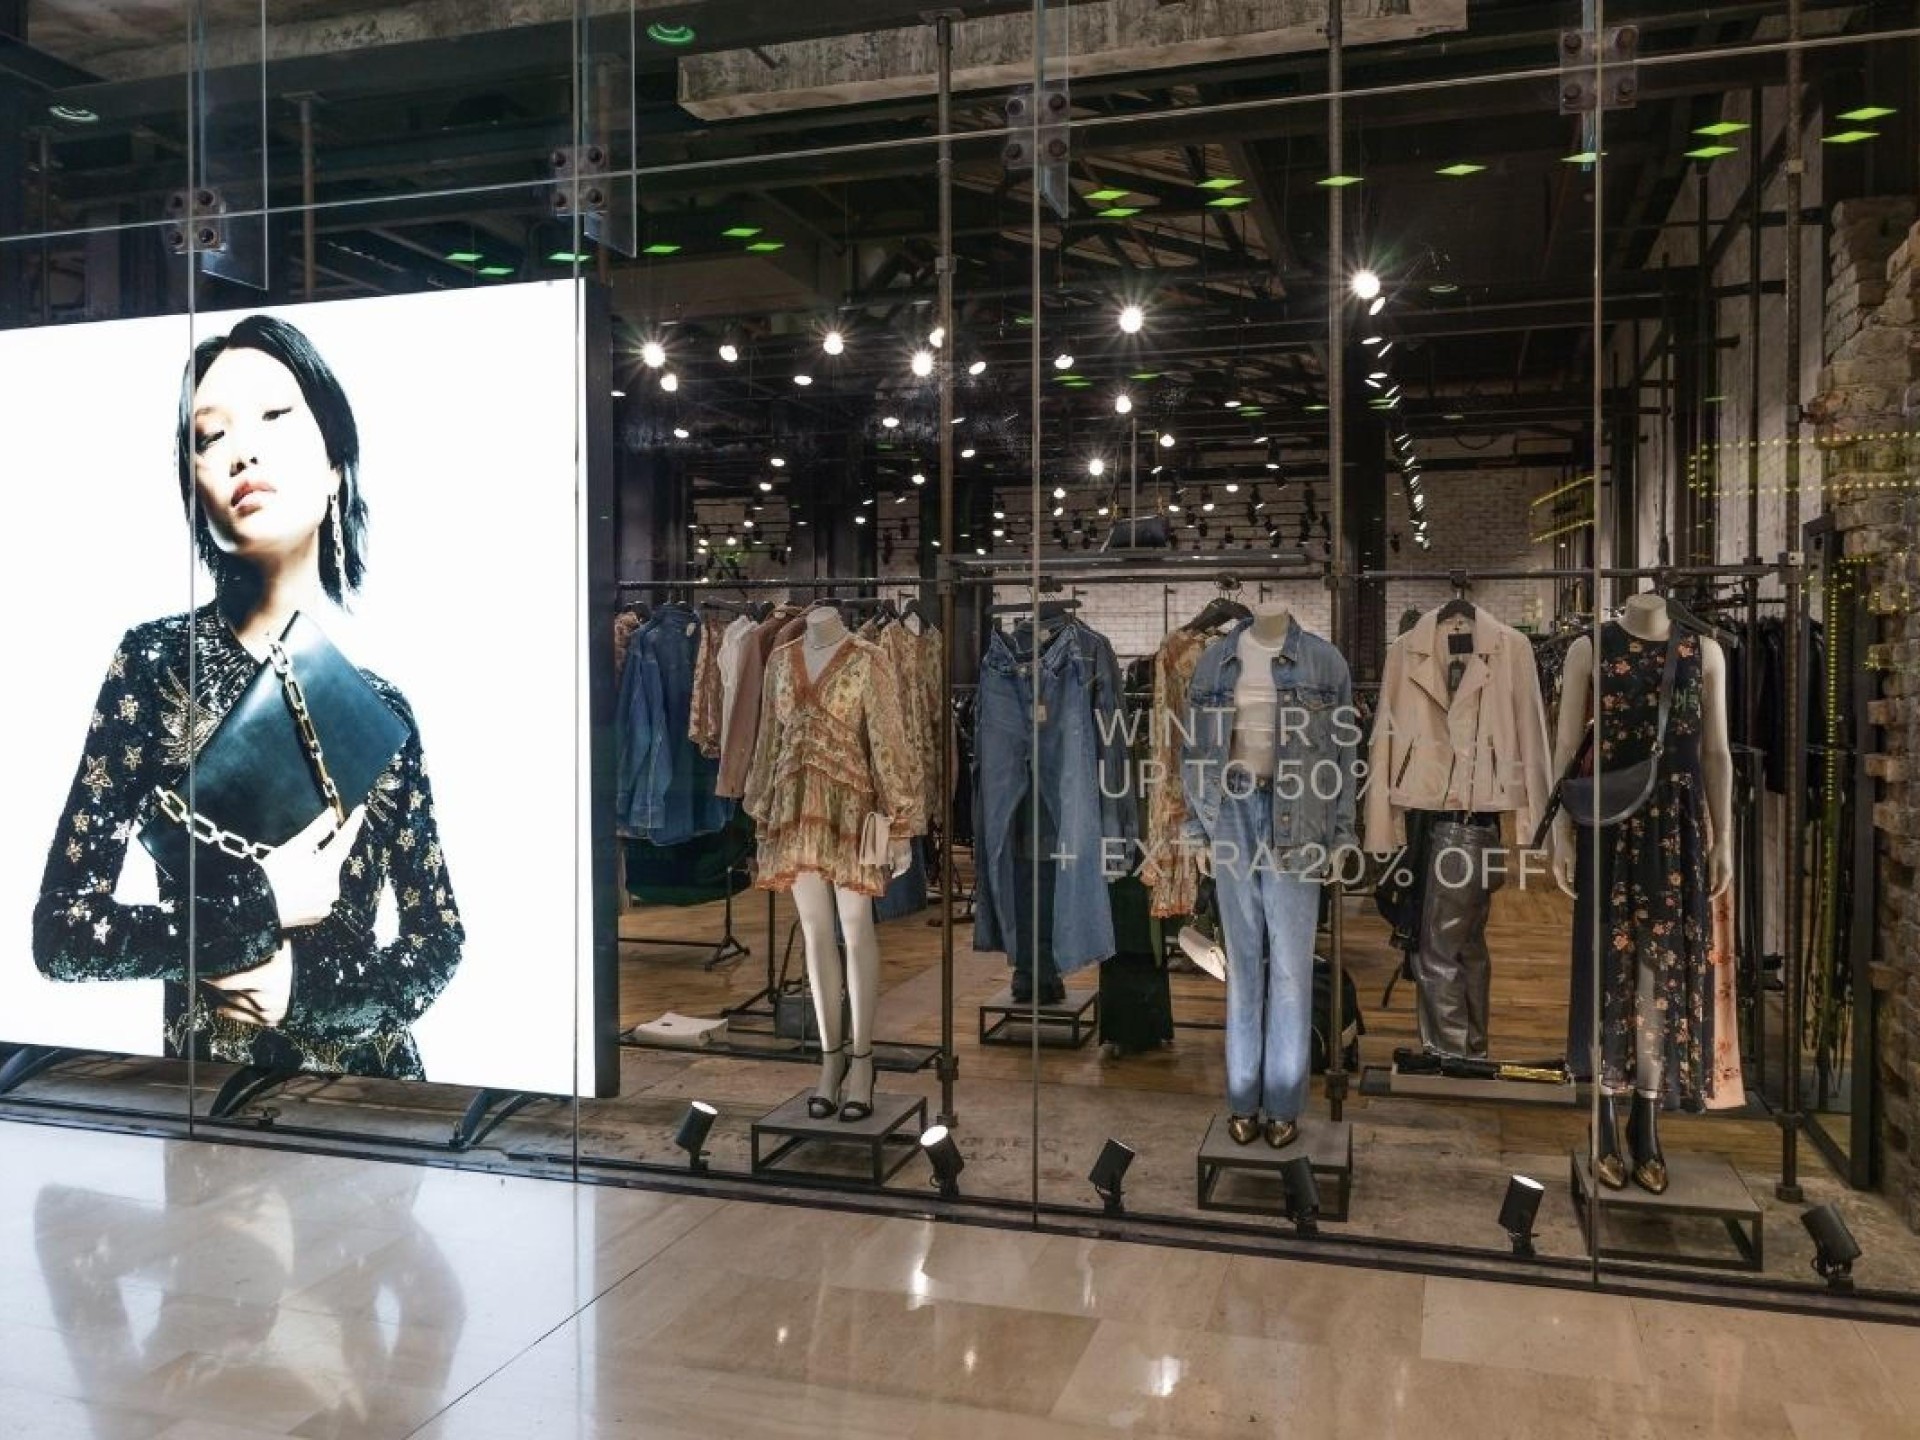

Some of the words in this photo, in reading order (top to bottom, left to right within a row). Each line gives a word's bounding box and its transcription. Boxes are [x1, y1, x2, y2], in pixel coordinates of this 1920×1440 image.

[1329, 704, 1479, 748] SA
[1097, 758, 1168, 800] UP
[1184, 757, 1256, 800] TO
[1101, 837, 1280, 882] EXTRA
[1299, 842, 1413, 888] 20%
[1434, 847, 1548, 891] OFF
